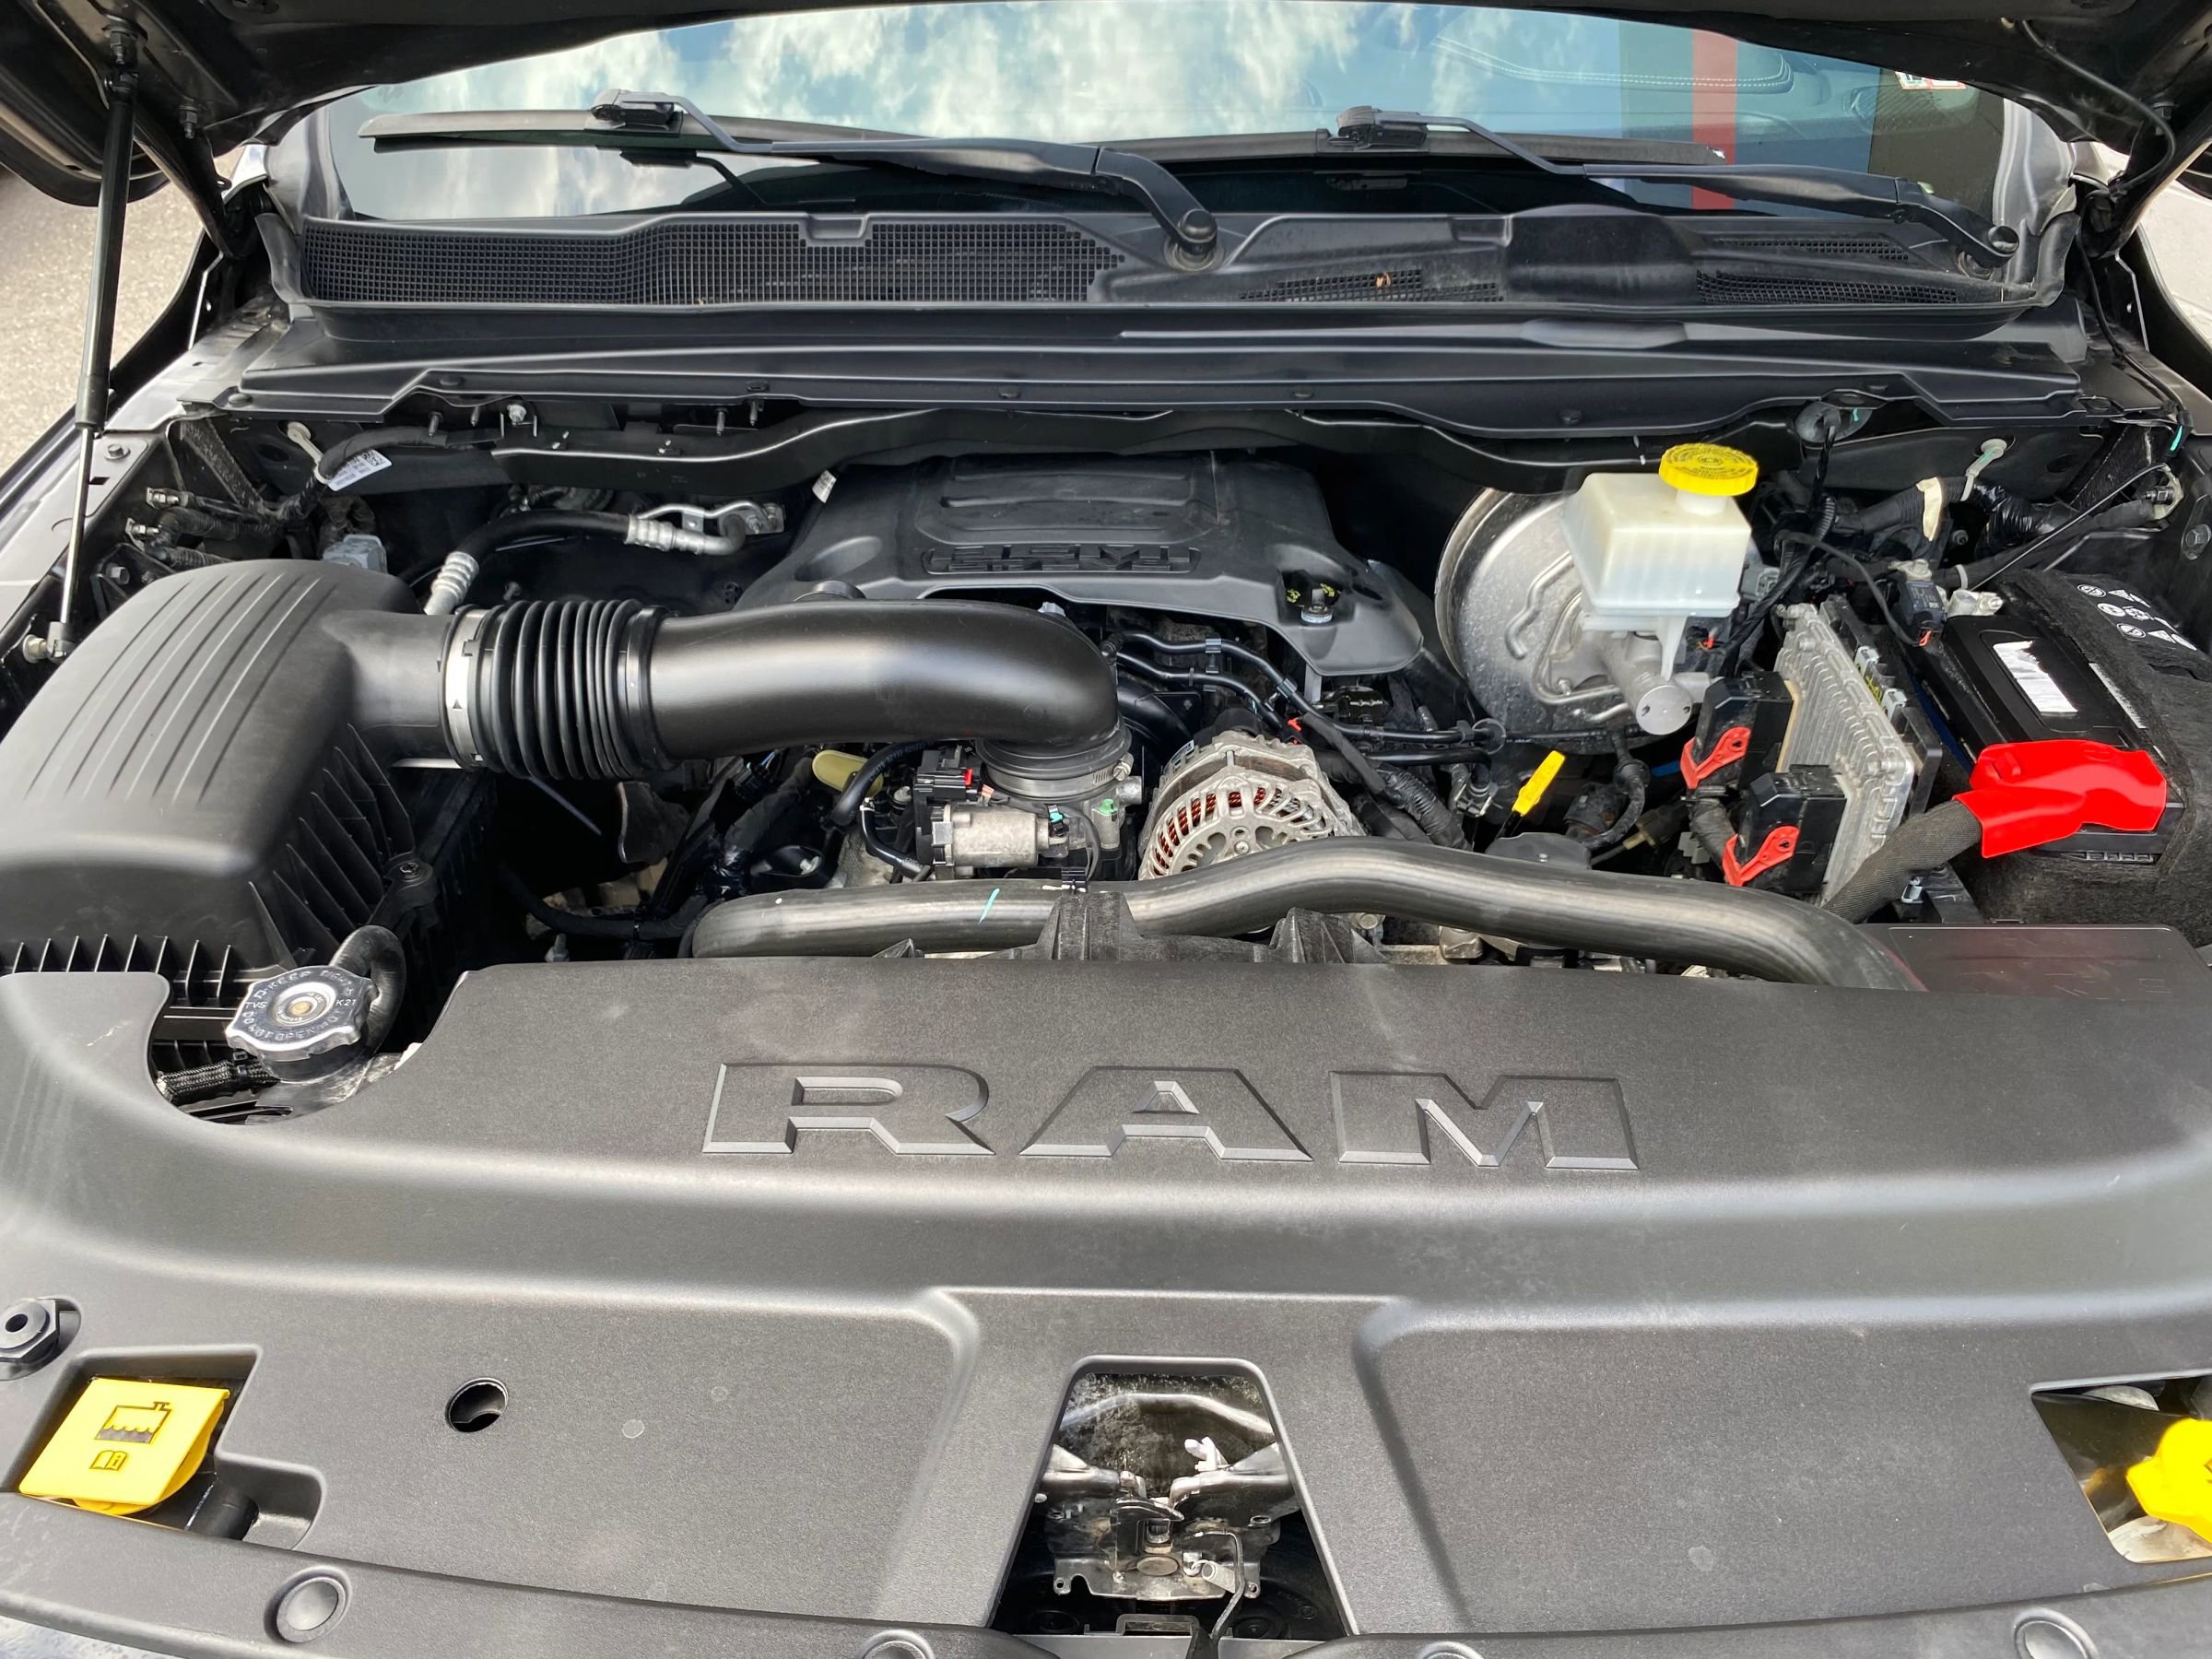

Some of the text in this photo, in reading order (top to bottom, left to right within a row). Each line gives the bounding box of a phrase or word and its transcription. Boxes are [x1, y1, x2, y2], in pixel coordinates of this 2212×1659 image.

[269, 971, 312, 989] KEEP
[245, 1001, 267, 1009] TVS
[243, 1011, 255, 1025] DO
[248, 1025, 274, 1039] NOT
[275, 1028, 316, 1041] OPEN
[703, 1062, 1639, 1171] RAM
